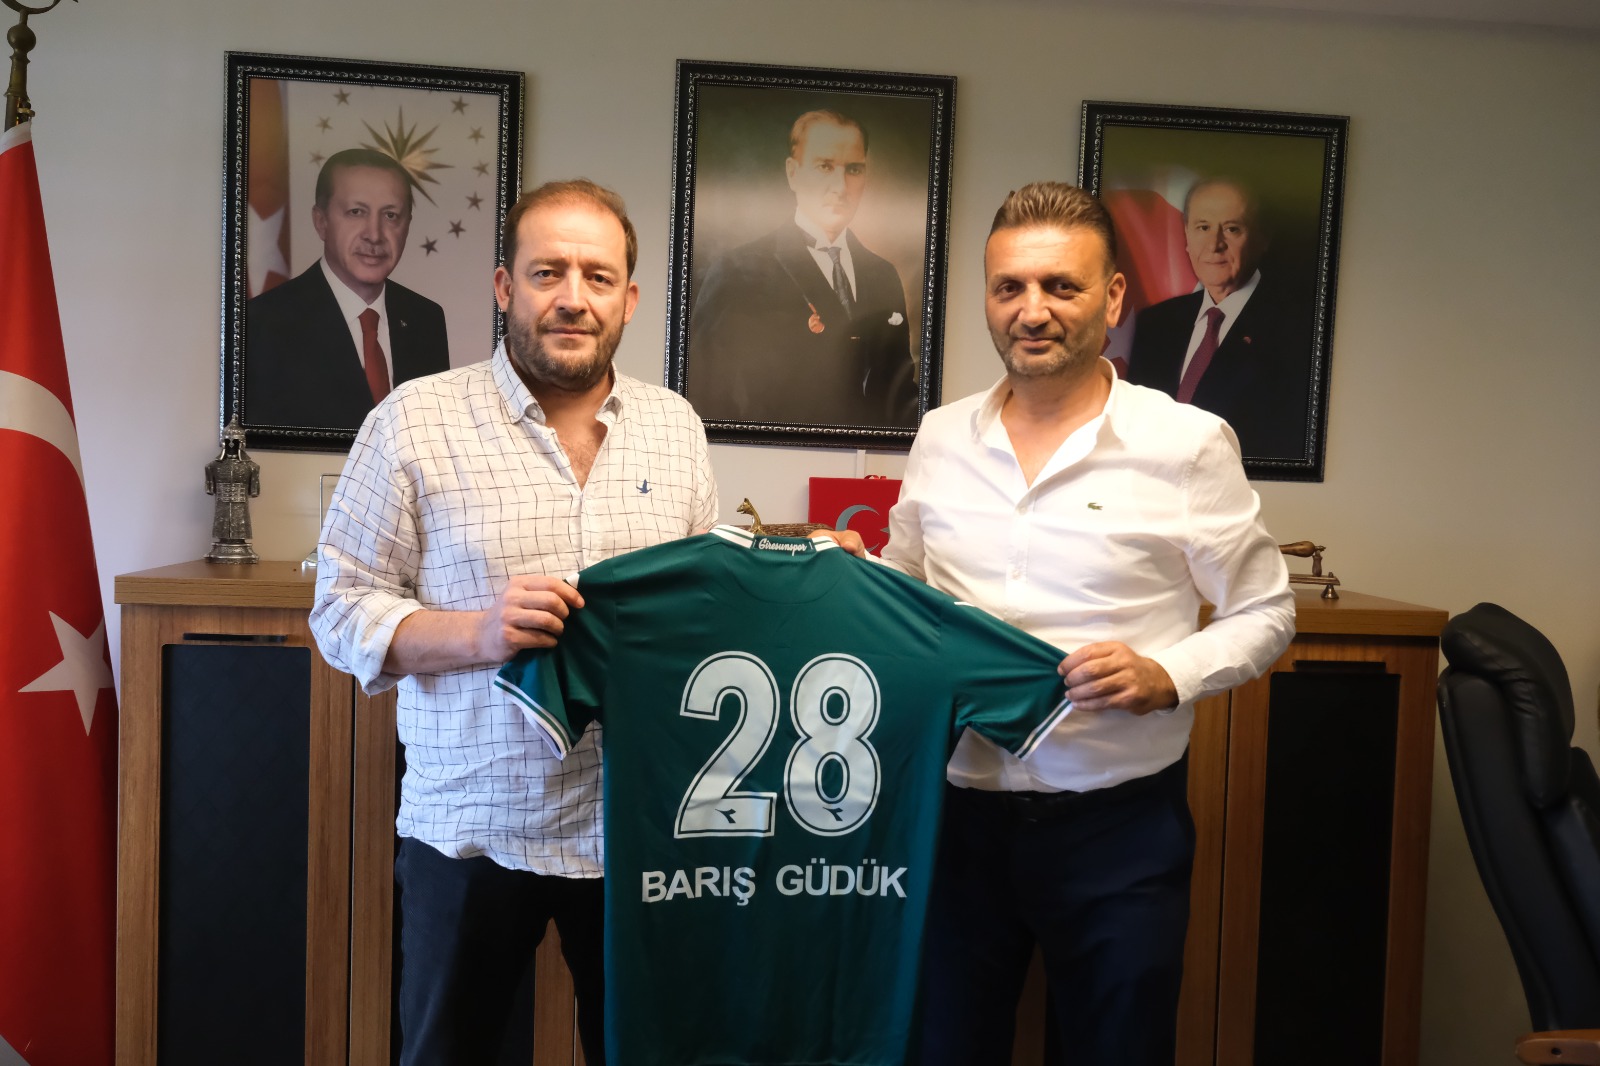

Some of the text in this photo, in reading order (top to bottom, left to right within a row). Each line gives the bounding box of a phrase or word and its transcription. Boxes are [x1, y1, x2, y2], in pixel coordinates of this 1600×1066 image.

[758, 538, 808, 556] Giresunspor
[674, 650, 882, 839] 28
[641, 858, 908, 906] BARIŞ GÜDÜK
